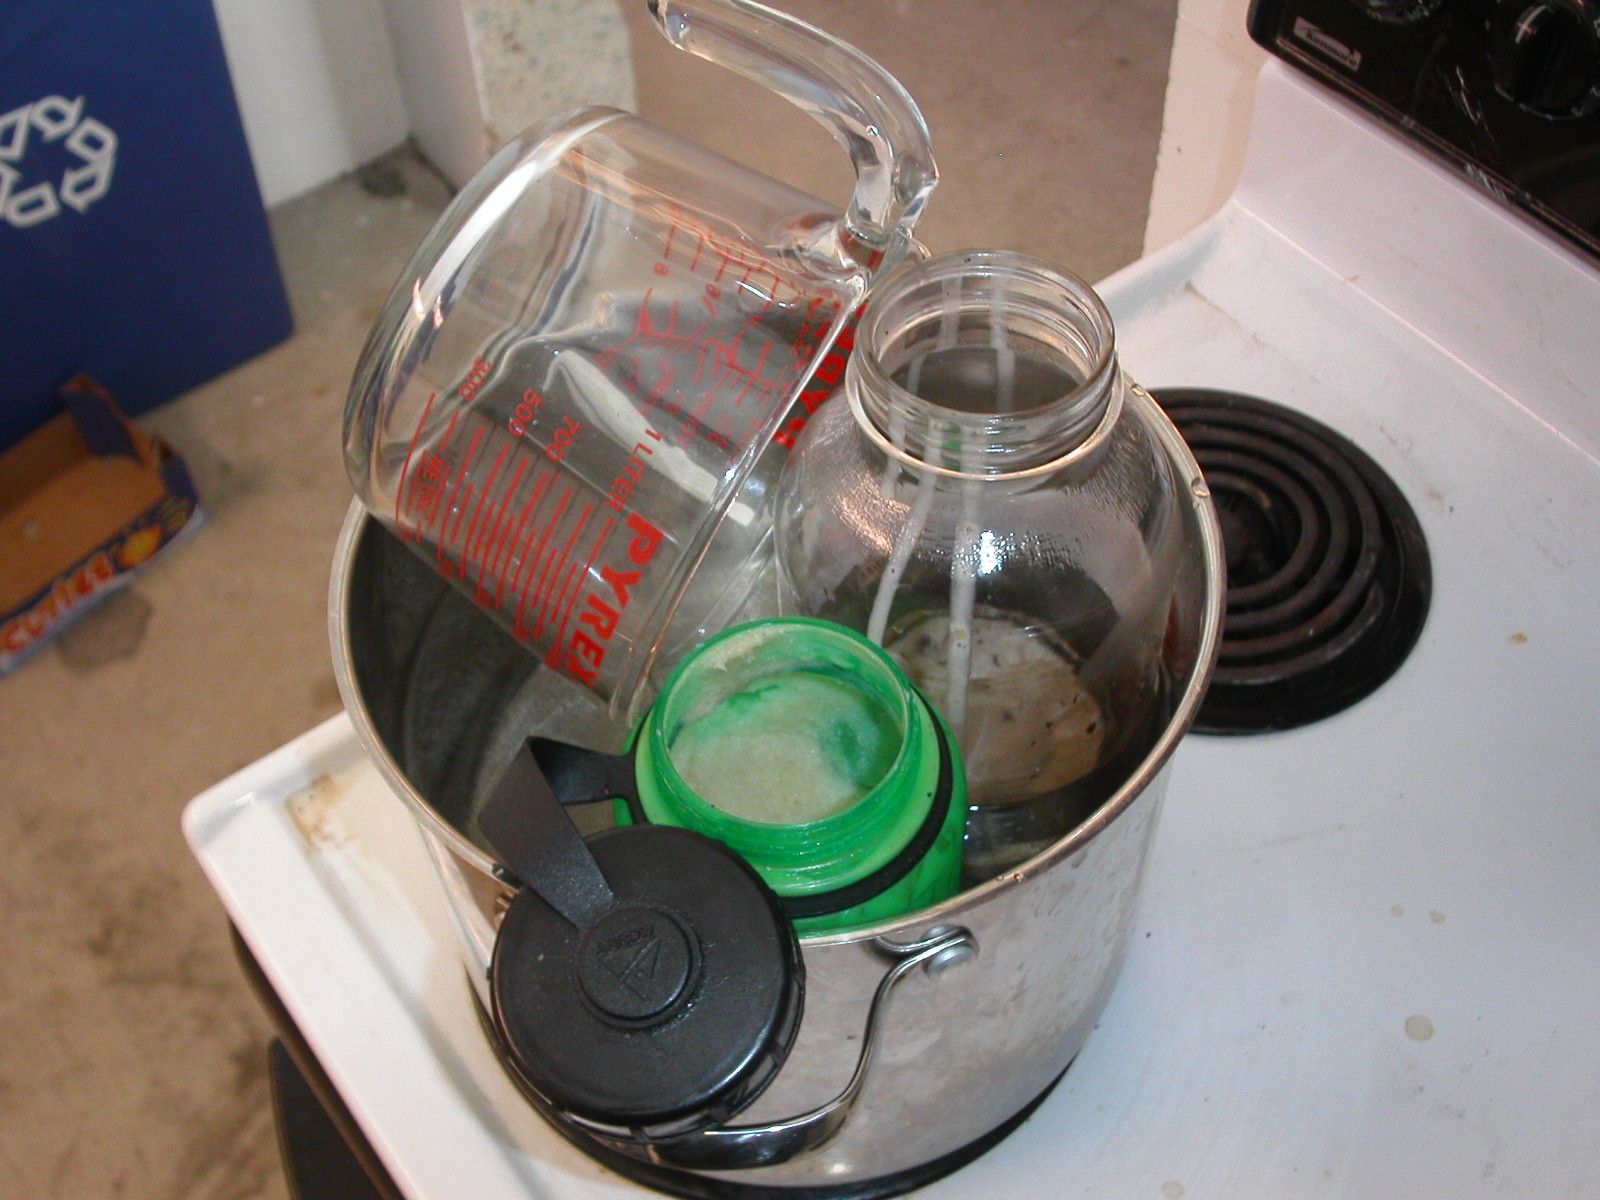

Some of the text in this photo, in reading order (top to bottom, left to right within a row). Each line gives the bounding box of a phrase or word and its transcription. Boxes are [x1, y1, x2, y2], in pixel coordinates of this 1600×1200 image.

[507, 389, 543, 437] 500
[545, 415, 582, 462] 700
[604, 428, 664, 512] 1 LITER
[562, 512, 664, 689] PYREX
